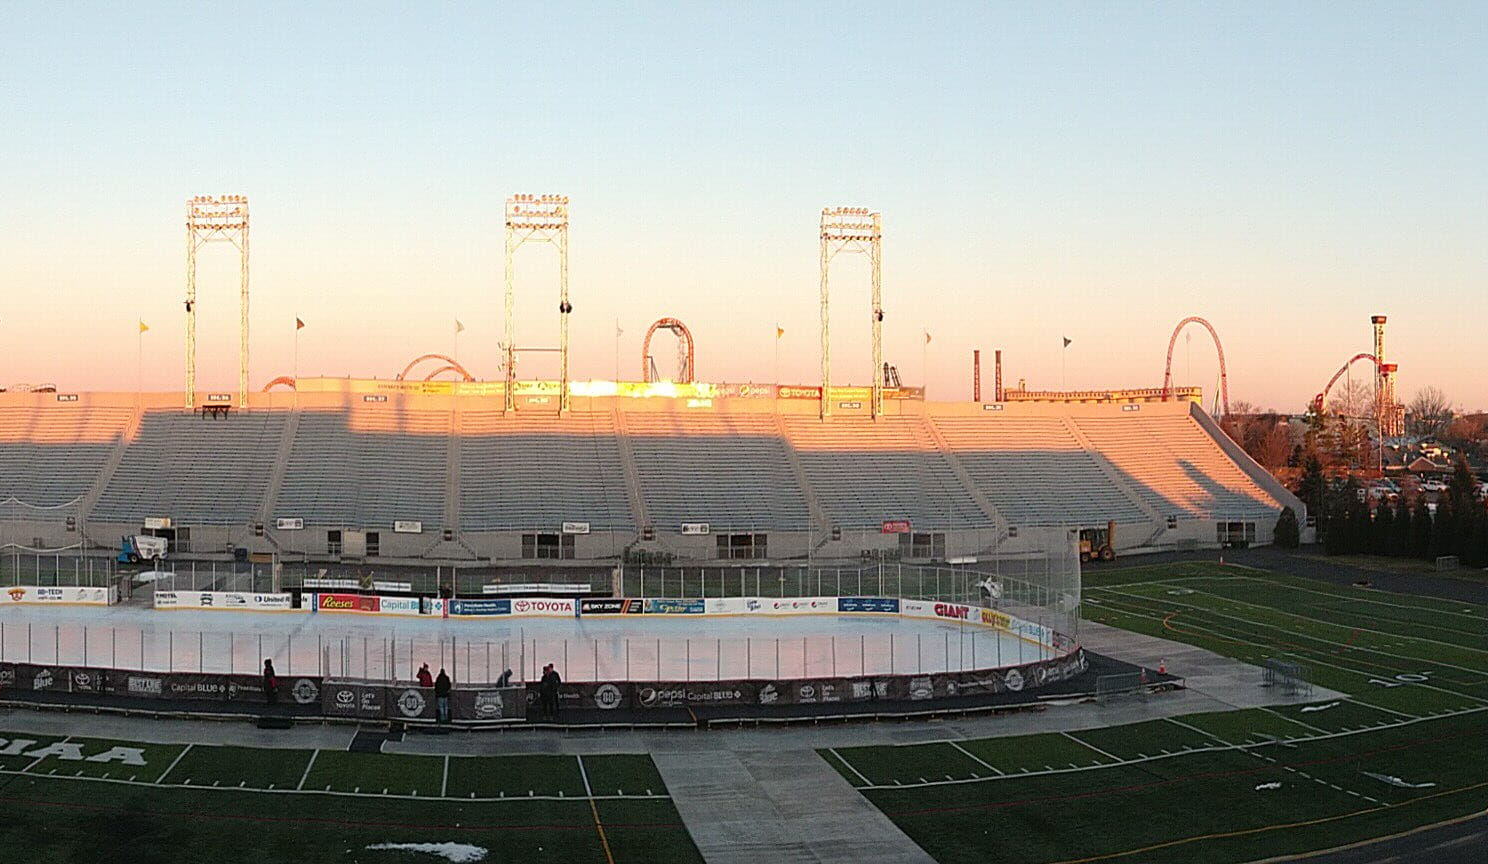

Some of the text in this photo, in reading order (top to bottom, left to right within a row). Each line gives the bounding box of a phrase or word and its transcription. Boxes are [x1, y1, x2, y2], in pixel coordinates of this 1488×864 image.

[791, 388, 819, 397] TOYOTA
[263, 595, 283, 603] United
[381, 599, 410, 612] Capital
[530, 601, 572, 612] TOYOTA
[934, 603, 970, 620] GIANT
[33, 676, 53, 690] Blue
[171, 683, 196, 694] Capital
[197, 684, 218, 693] BLUE
[603, 691, 614, 702] 80
[658, 689, 686, 702] pepsi
[688, 691, 713, 701] Capital
